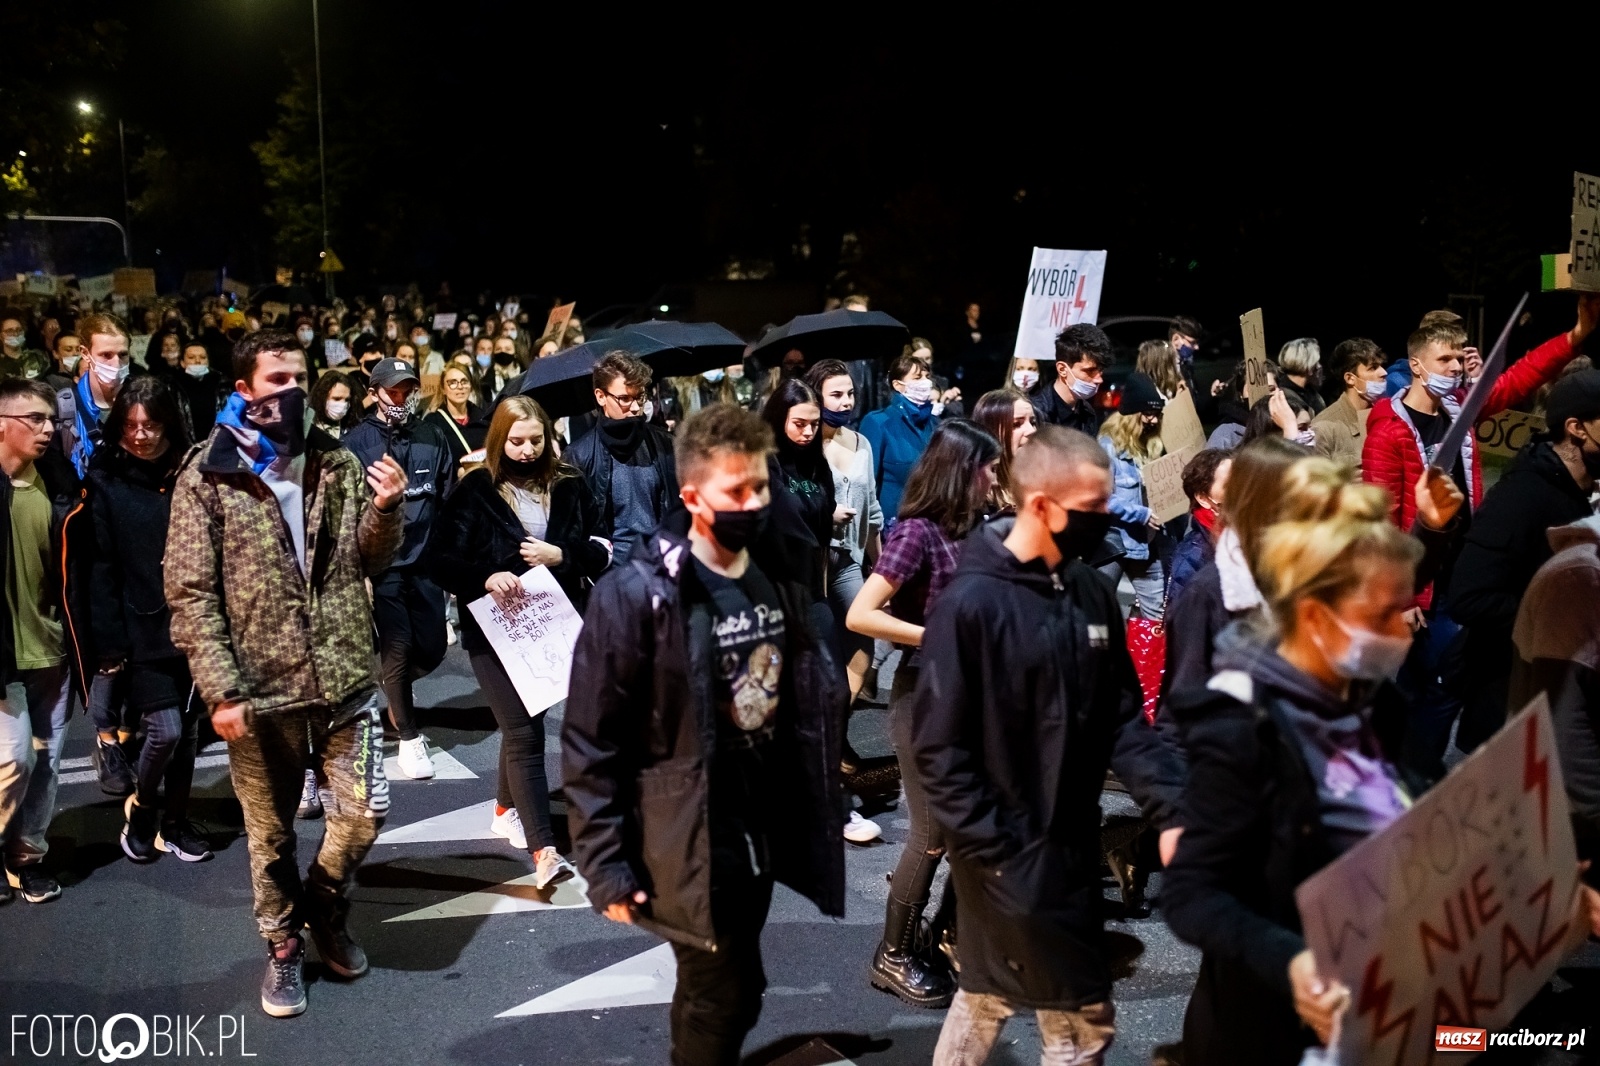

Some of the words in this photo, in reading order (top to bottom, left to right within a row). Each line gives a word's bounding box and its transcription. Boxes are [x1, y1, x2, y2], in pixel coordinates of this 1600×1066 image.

[1028, 263, 1077, 297] WYBÓR
[1049, 301, 1073, 329] NIE
[1151, 452, 1186, 483] GODEK
[490, 597, 515, 616] MILION
[493, 612, 510, 625] TAK
[508, 599, 533, 616] TERAZ
[531, 608, 538, 617] Z
[538, 601, 554, 611] NAS
[508, 630, 525, 643] SIĘ
[539, 612, 553, 626] NIE
[353, 718, 372, 775] Original
[1419, 863, 1503, 976] NIE
